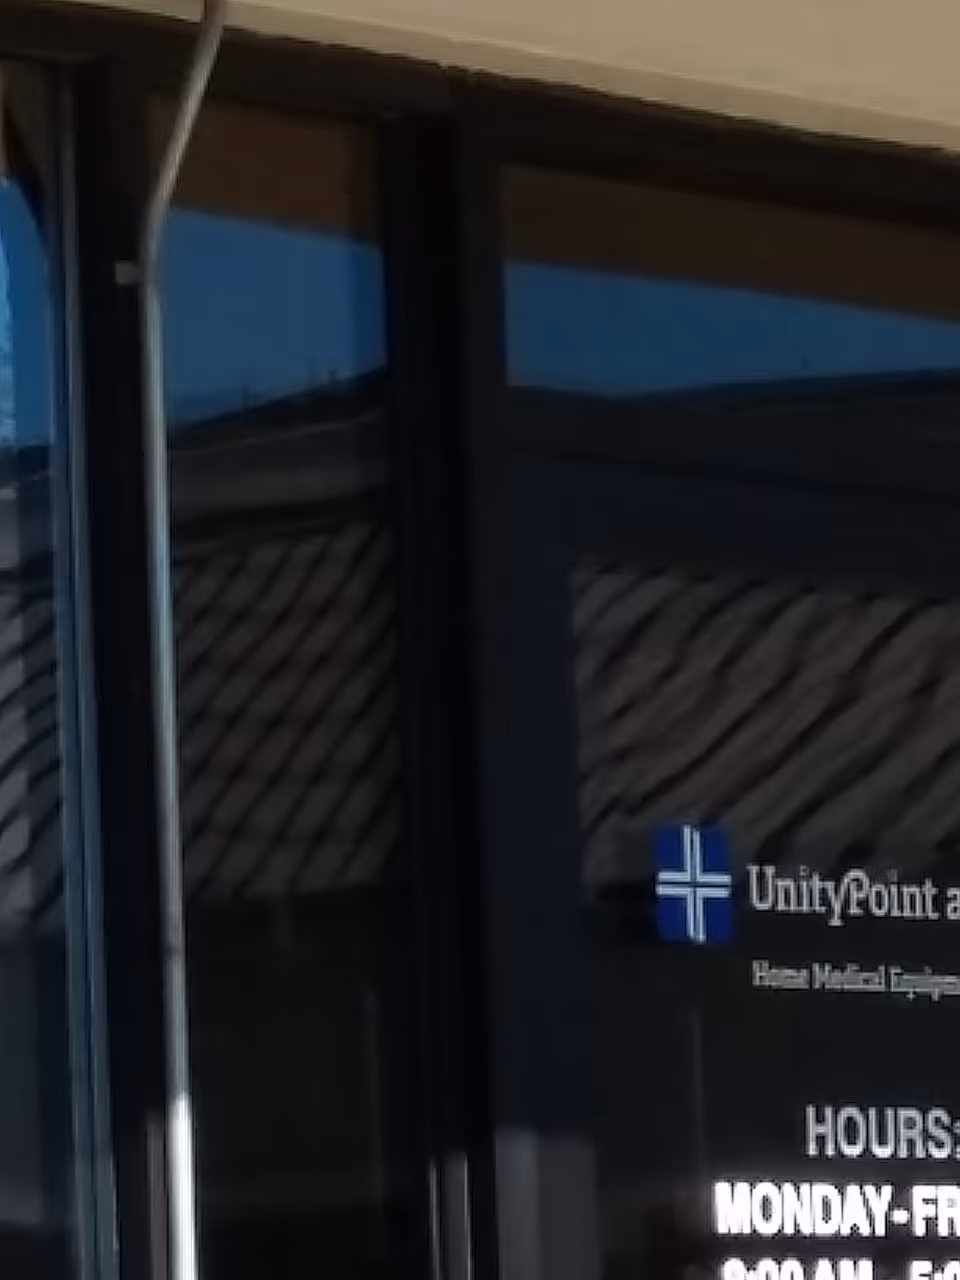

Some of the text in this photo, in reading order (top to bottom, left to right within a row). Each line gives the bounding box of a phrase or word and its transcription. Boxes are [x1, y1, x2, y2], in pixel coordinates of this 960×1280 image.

[746, 862, 940, 927] UnityPoint
[752, 959, 810, 990] Home
[811, 963, 886, 992] Medical
